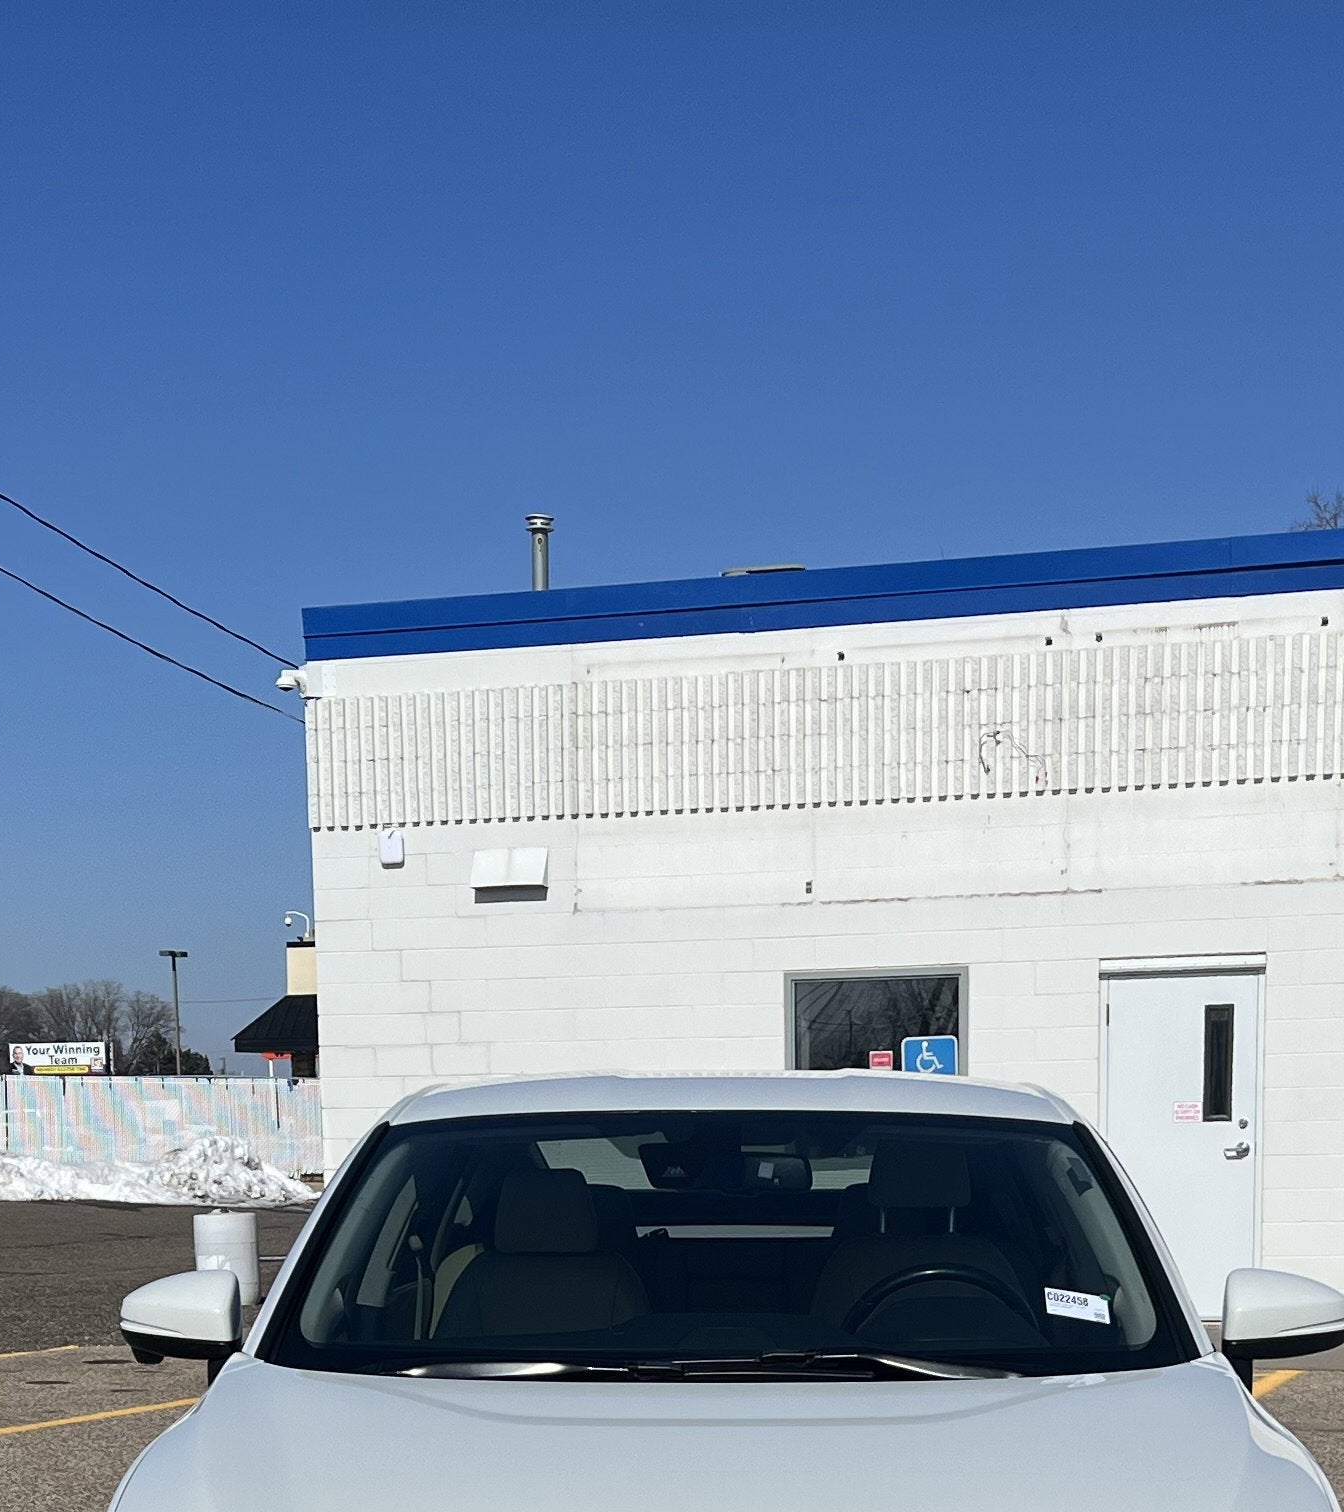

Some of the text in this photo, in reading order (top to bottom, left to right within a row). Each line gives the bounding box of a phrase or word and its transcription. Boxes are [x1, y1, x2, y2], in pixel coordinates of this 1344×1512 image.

[25, 1044, 100, 1056] Your Winning
[48, 1055, 78, 1065] Team
